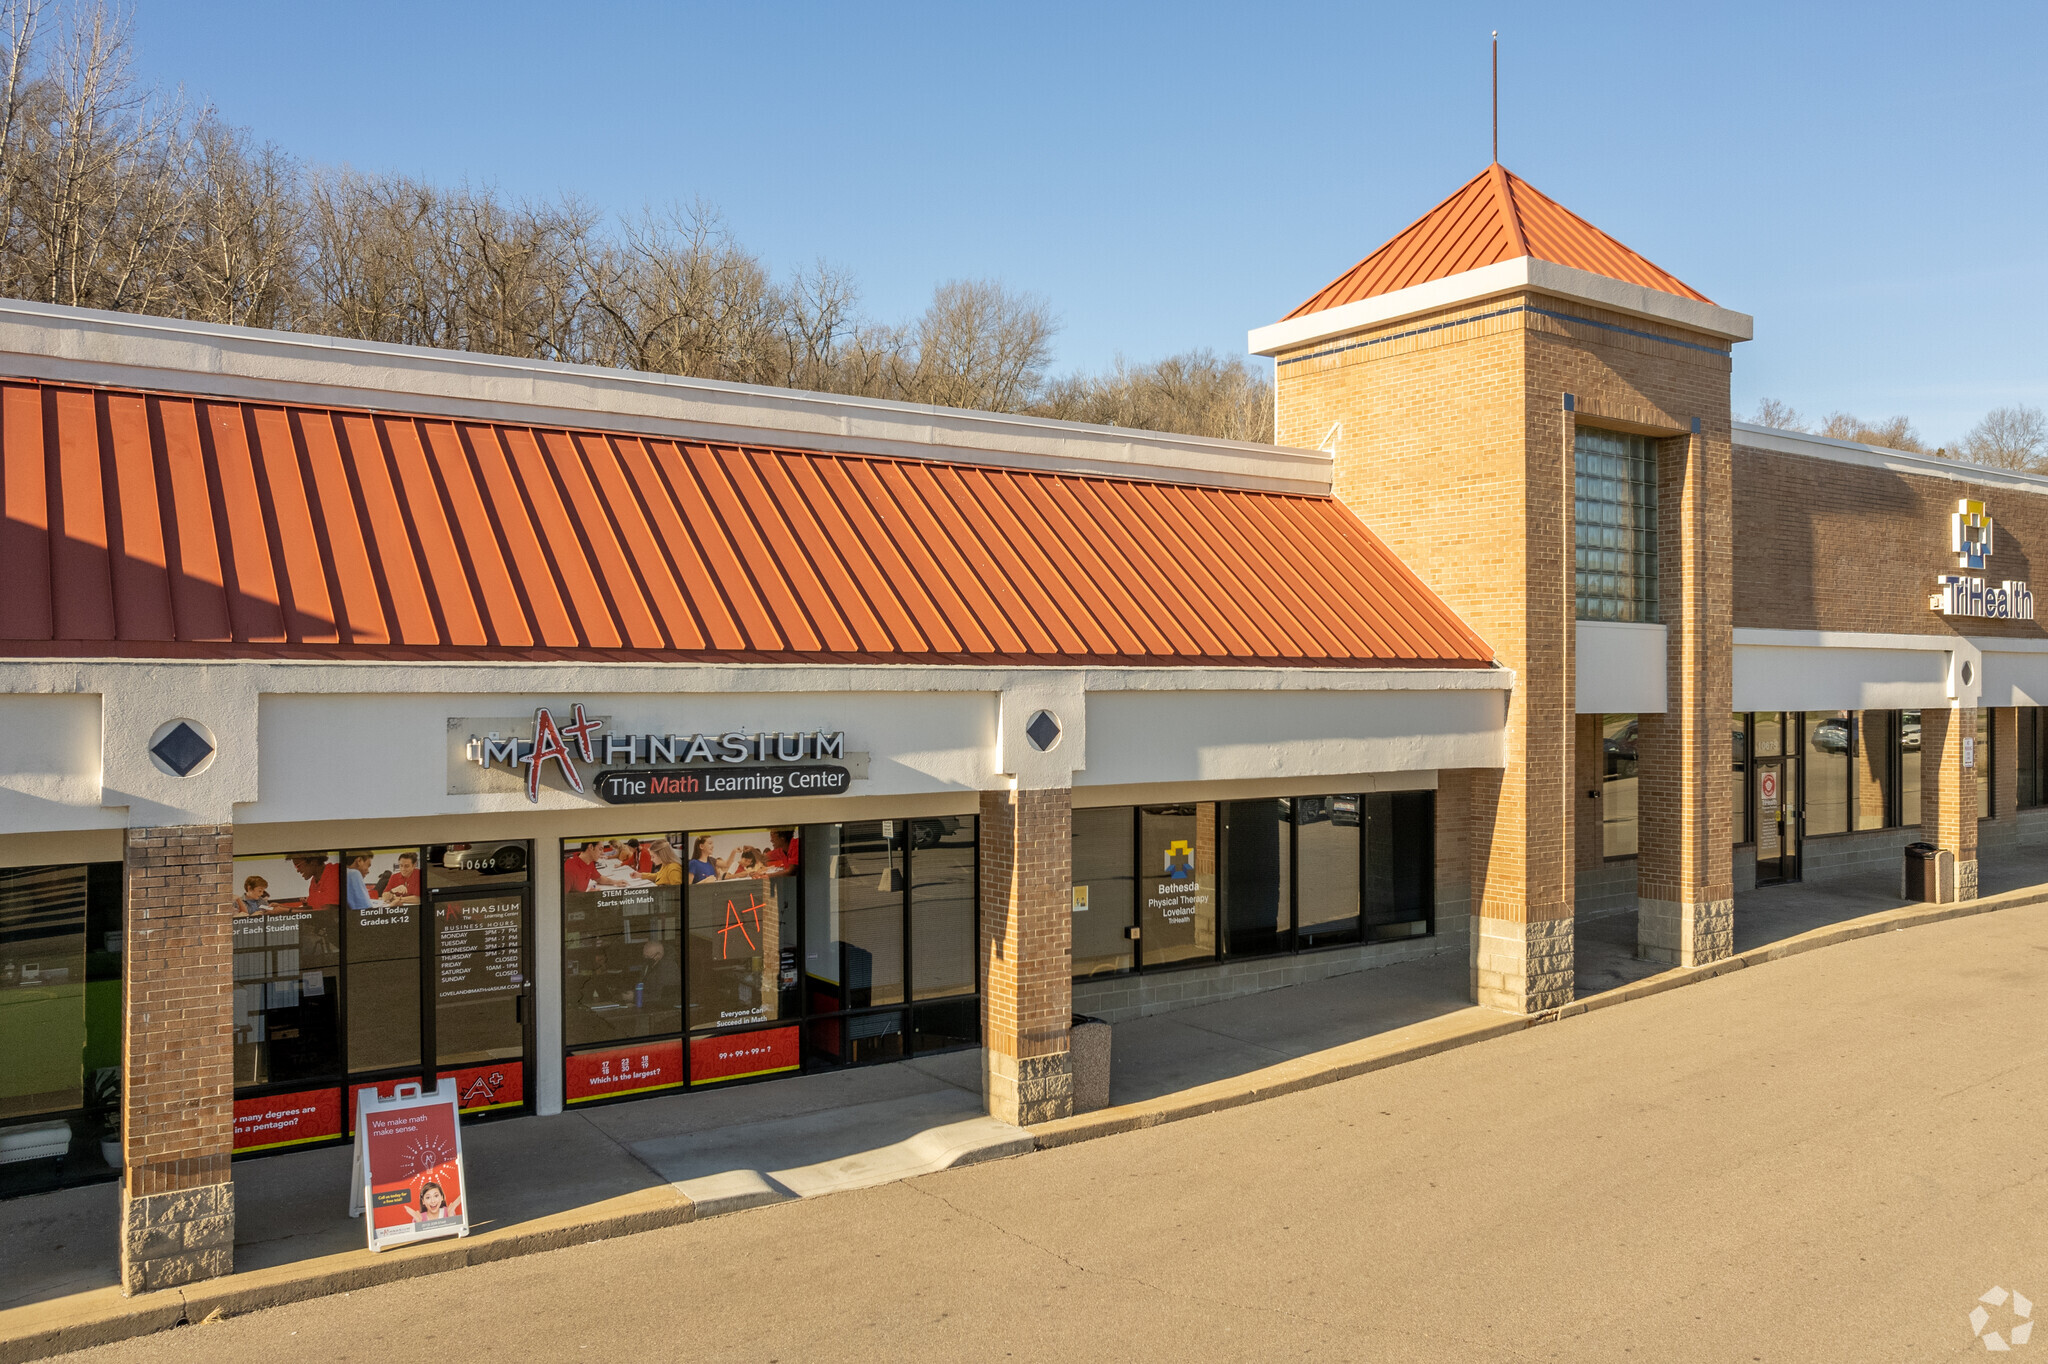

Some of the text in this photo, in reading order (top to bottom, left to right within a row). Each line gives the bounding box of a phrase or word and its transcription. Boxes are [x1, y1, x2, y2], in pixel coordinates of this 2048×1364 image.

[1945, 575, 2034, 620] TriHealth
[609, 771, 845, 796] The Math Learning Center
[460, 858, 496, 870] 10669
[602, 888, 649, 898] STEM Success
[1158, 881, 1200, 895] Bethesda
[597, 896, 654, 908] Starts with Math
[1148, 894, 1209, 909] Physical Therapy
[360, 906, 409, 917] Enroll Today
[1162, 906, 1196, 917] Loveland
[233, 912, 312, 925] omized Instruction
[360, 915, 409, 927] Grades K-12
[243, 926, 264, 935] Each
[265, 923, 299, 933] Student
[444, 923, 484, 931] BUSINESS
[441, 939, 467, 947] TUESDAY
[441, 945, 478, 954] WEDNESDAY
[441, 953, 472, 961] THURSDAY
[441, 968, 471, 976] SATURDAY
[720, 1007, 764, 1018] Everyone Can
[716, 1018, 743, 1028] Succeed
[751, 1015, 768, 1024] Math
[718, 1052, 727, 1060] 99
[589, 1075, 611, 1085] Which
[620, 1073, 632, 1081] the
[632, 1068, 661, 1080] largest?
[239, 1113, 263, 1123] many
[265, 1108, 300, 1119] degrees
[302, 1106, 316, 1114] are
[234, 1126, 243, 1134] in
[253, 1117, 299, 1133] pentagon?
[372, 1114, 428, 1128] We make math
[373, 1125, 419, 1137] make sense.
